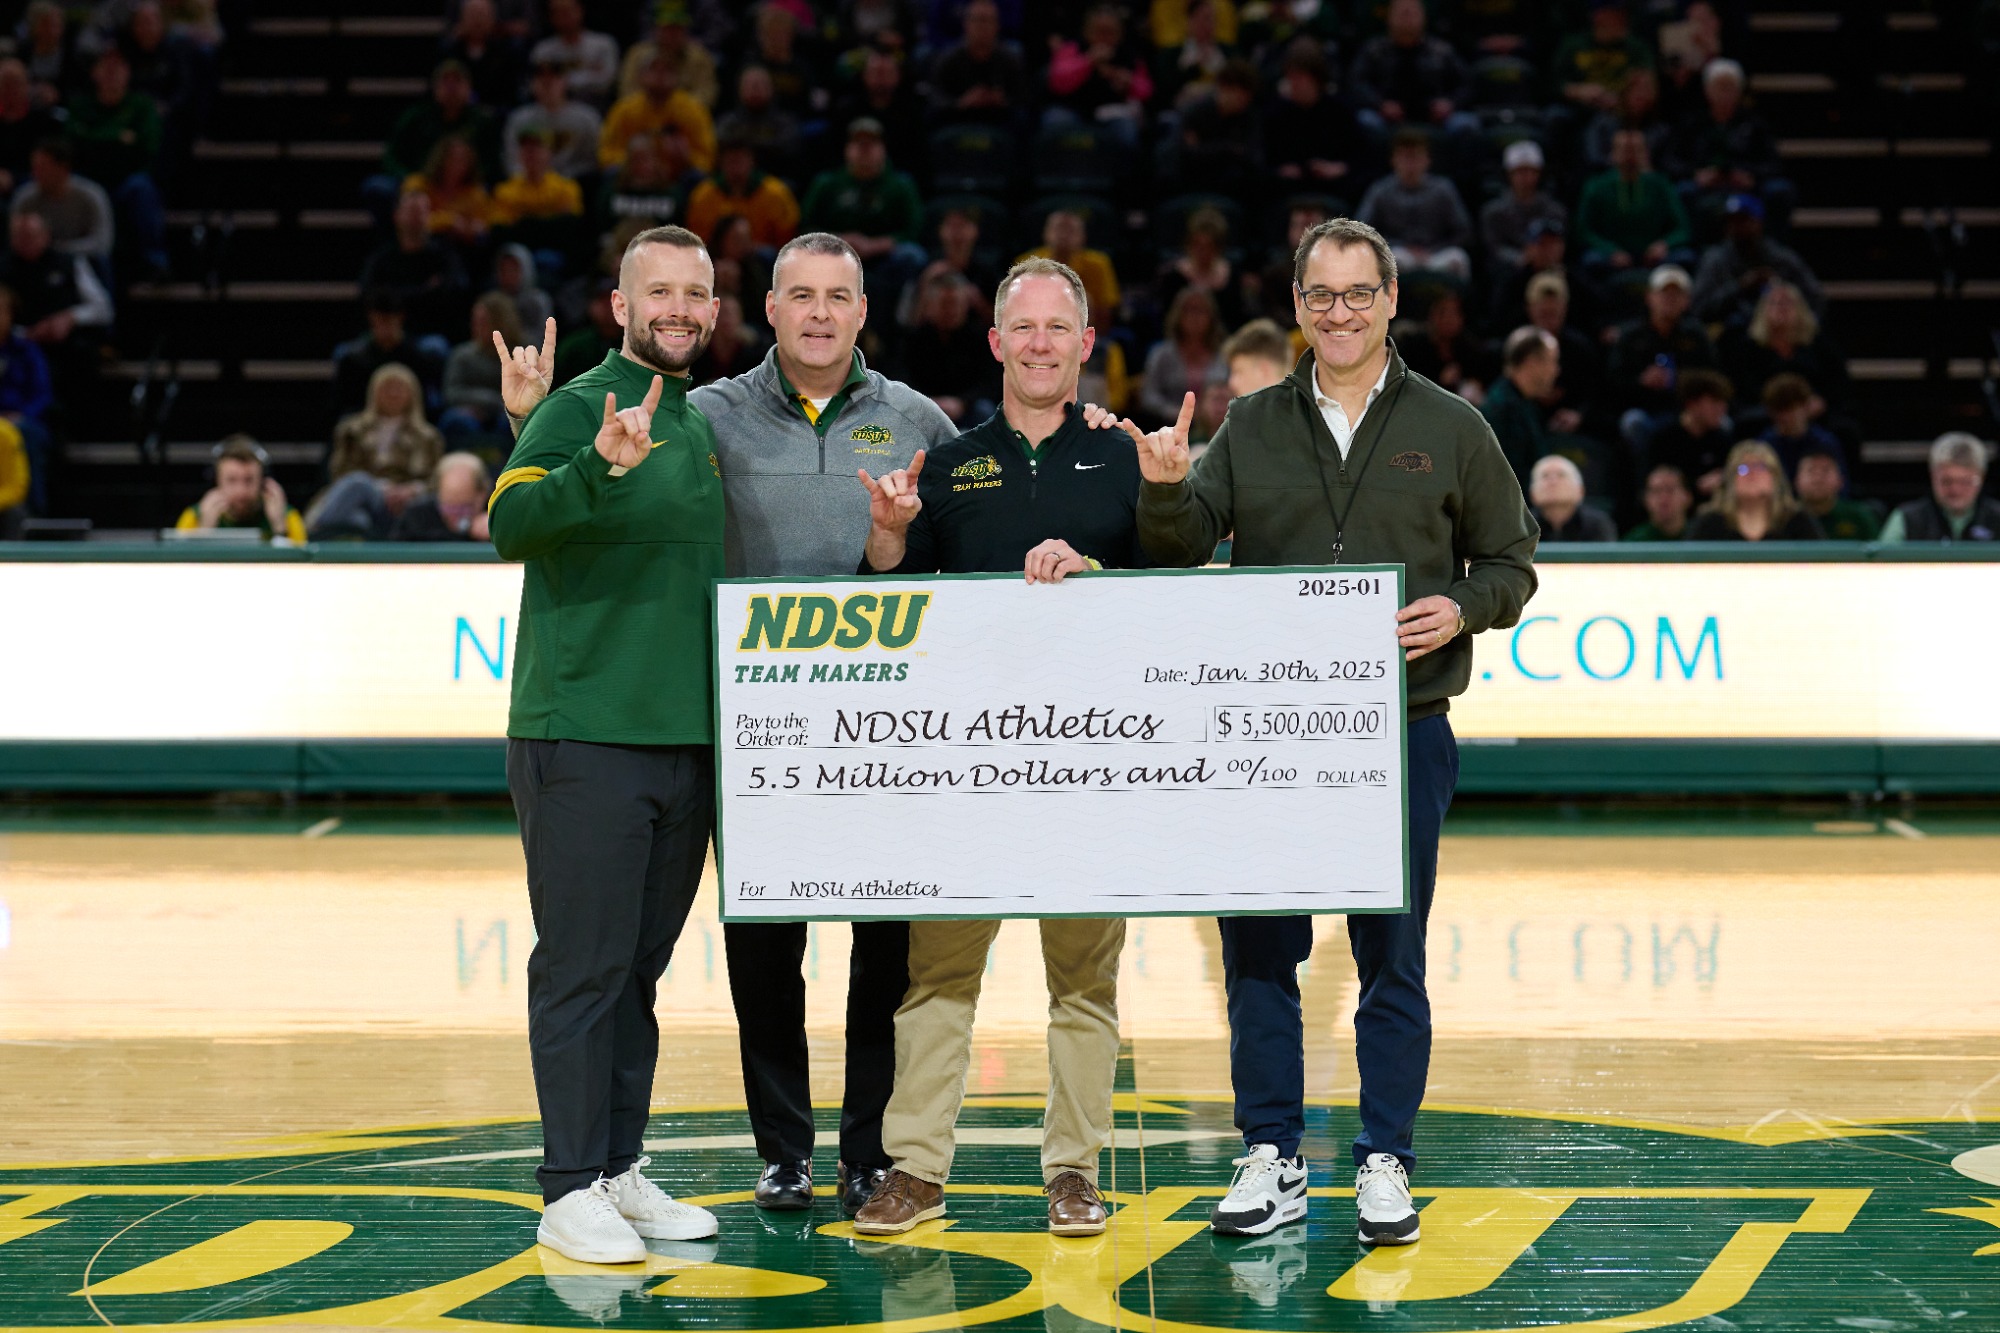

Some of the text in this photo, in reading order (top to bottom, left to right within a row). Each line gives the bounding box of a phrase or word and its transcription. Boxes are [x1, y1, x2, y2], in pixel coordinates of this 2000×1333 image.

[850, 430, 883, 441] NDSU
[1298, 578, 1381, 597] 2025-01
[737, 592, 933, 652] NDSU
[734, 662, 910, 684] TEAM MAKERS
[1144, 660, 1386, 686] Date: Jan. 30th, 2025
[736, 712, 809, 734] Pay to the
[833, 704, 1165, 743] NDSU Athletics
[1217, 709, 1380, 739] $ 5,500,000.00
[736, 729, 809, 746] Order of:
[748, 756, 1387, 790] 5.5 Million Dollars and 00/100 DOLLARS
[740, 879, 943, 898] For NDSU Athletics
